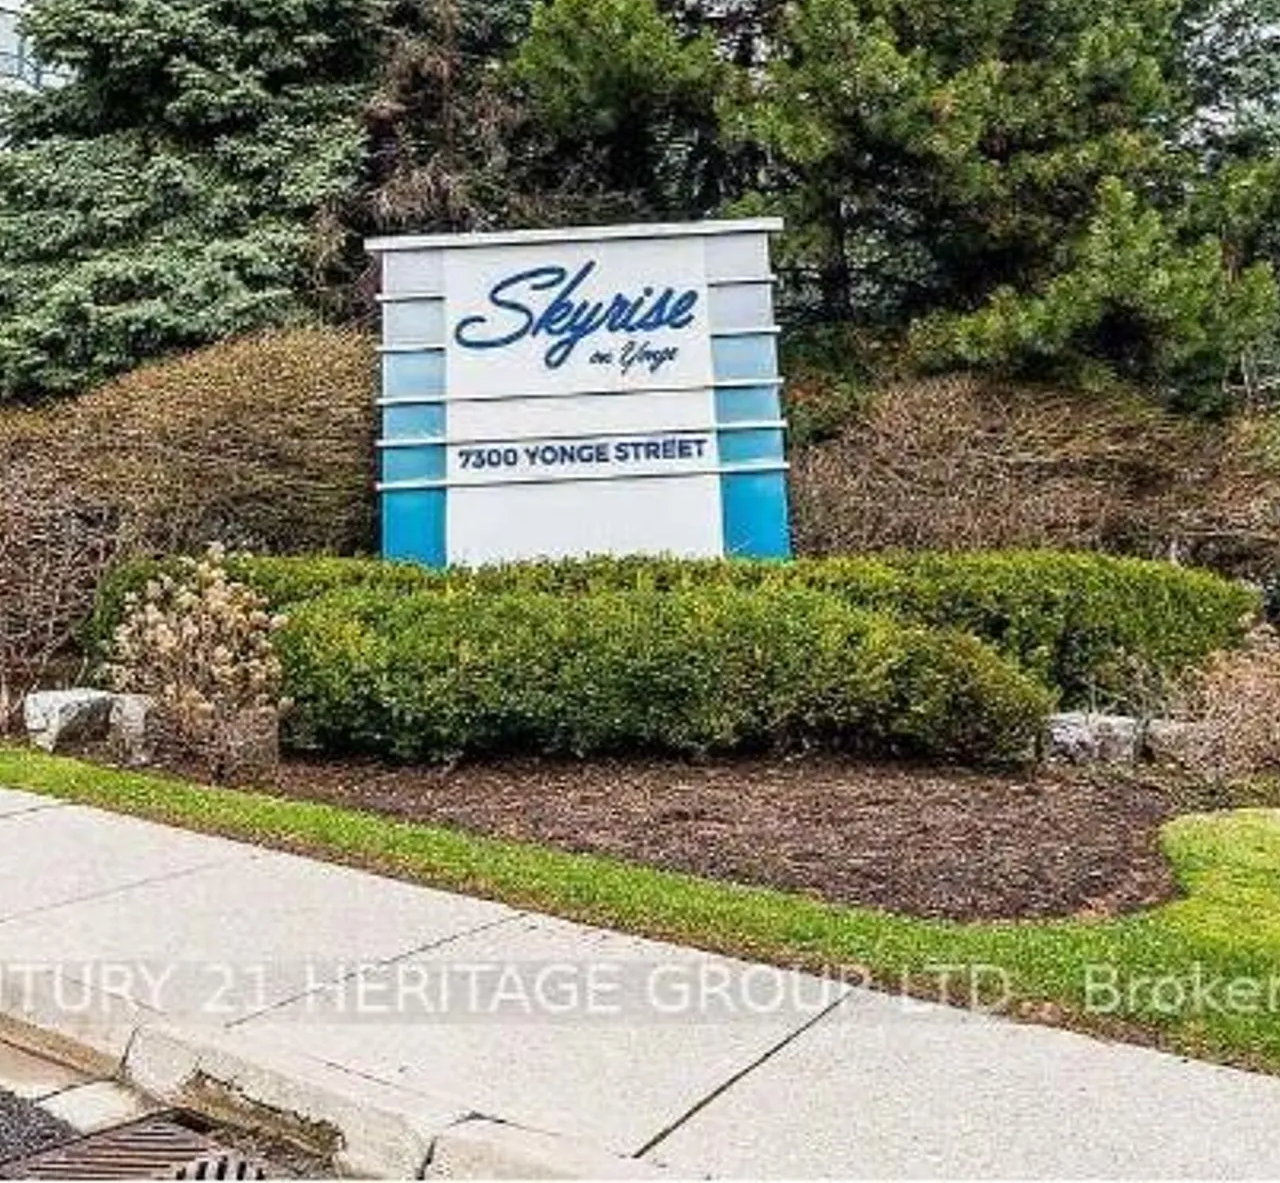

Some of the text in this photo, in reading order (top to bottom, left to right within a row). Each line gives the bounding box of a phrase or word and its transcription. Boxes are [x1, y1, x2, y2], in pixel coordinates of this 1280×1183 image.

[454, 260, 700, 369] Skyrise
[589, 341, 679, 376] on Yonge
[458, 438, 708, 469] 7300 YONGE STREET
